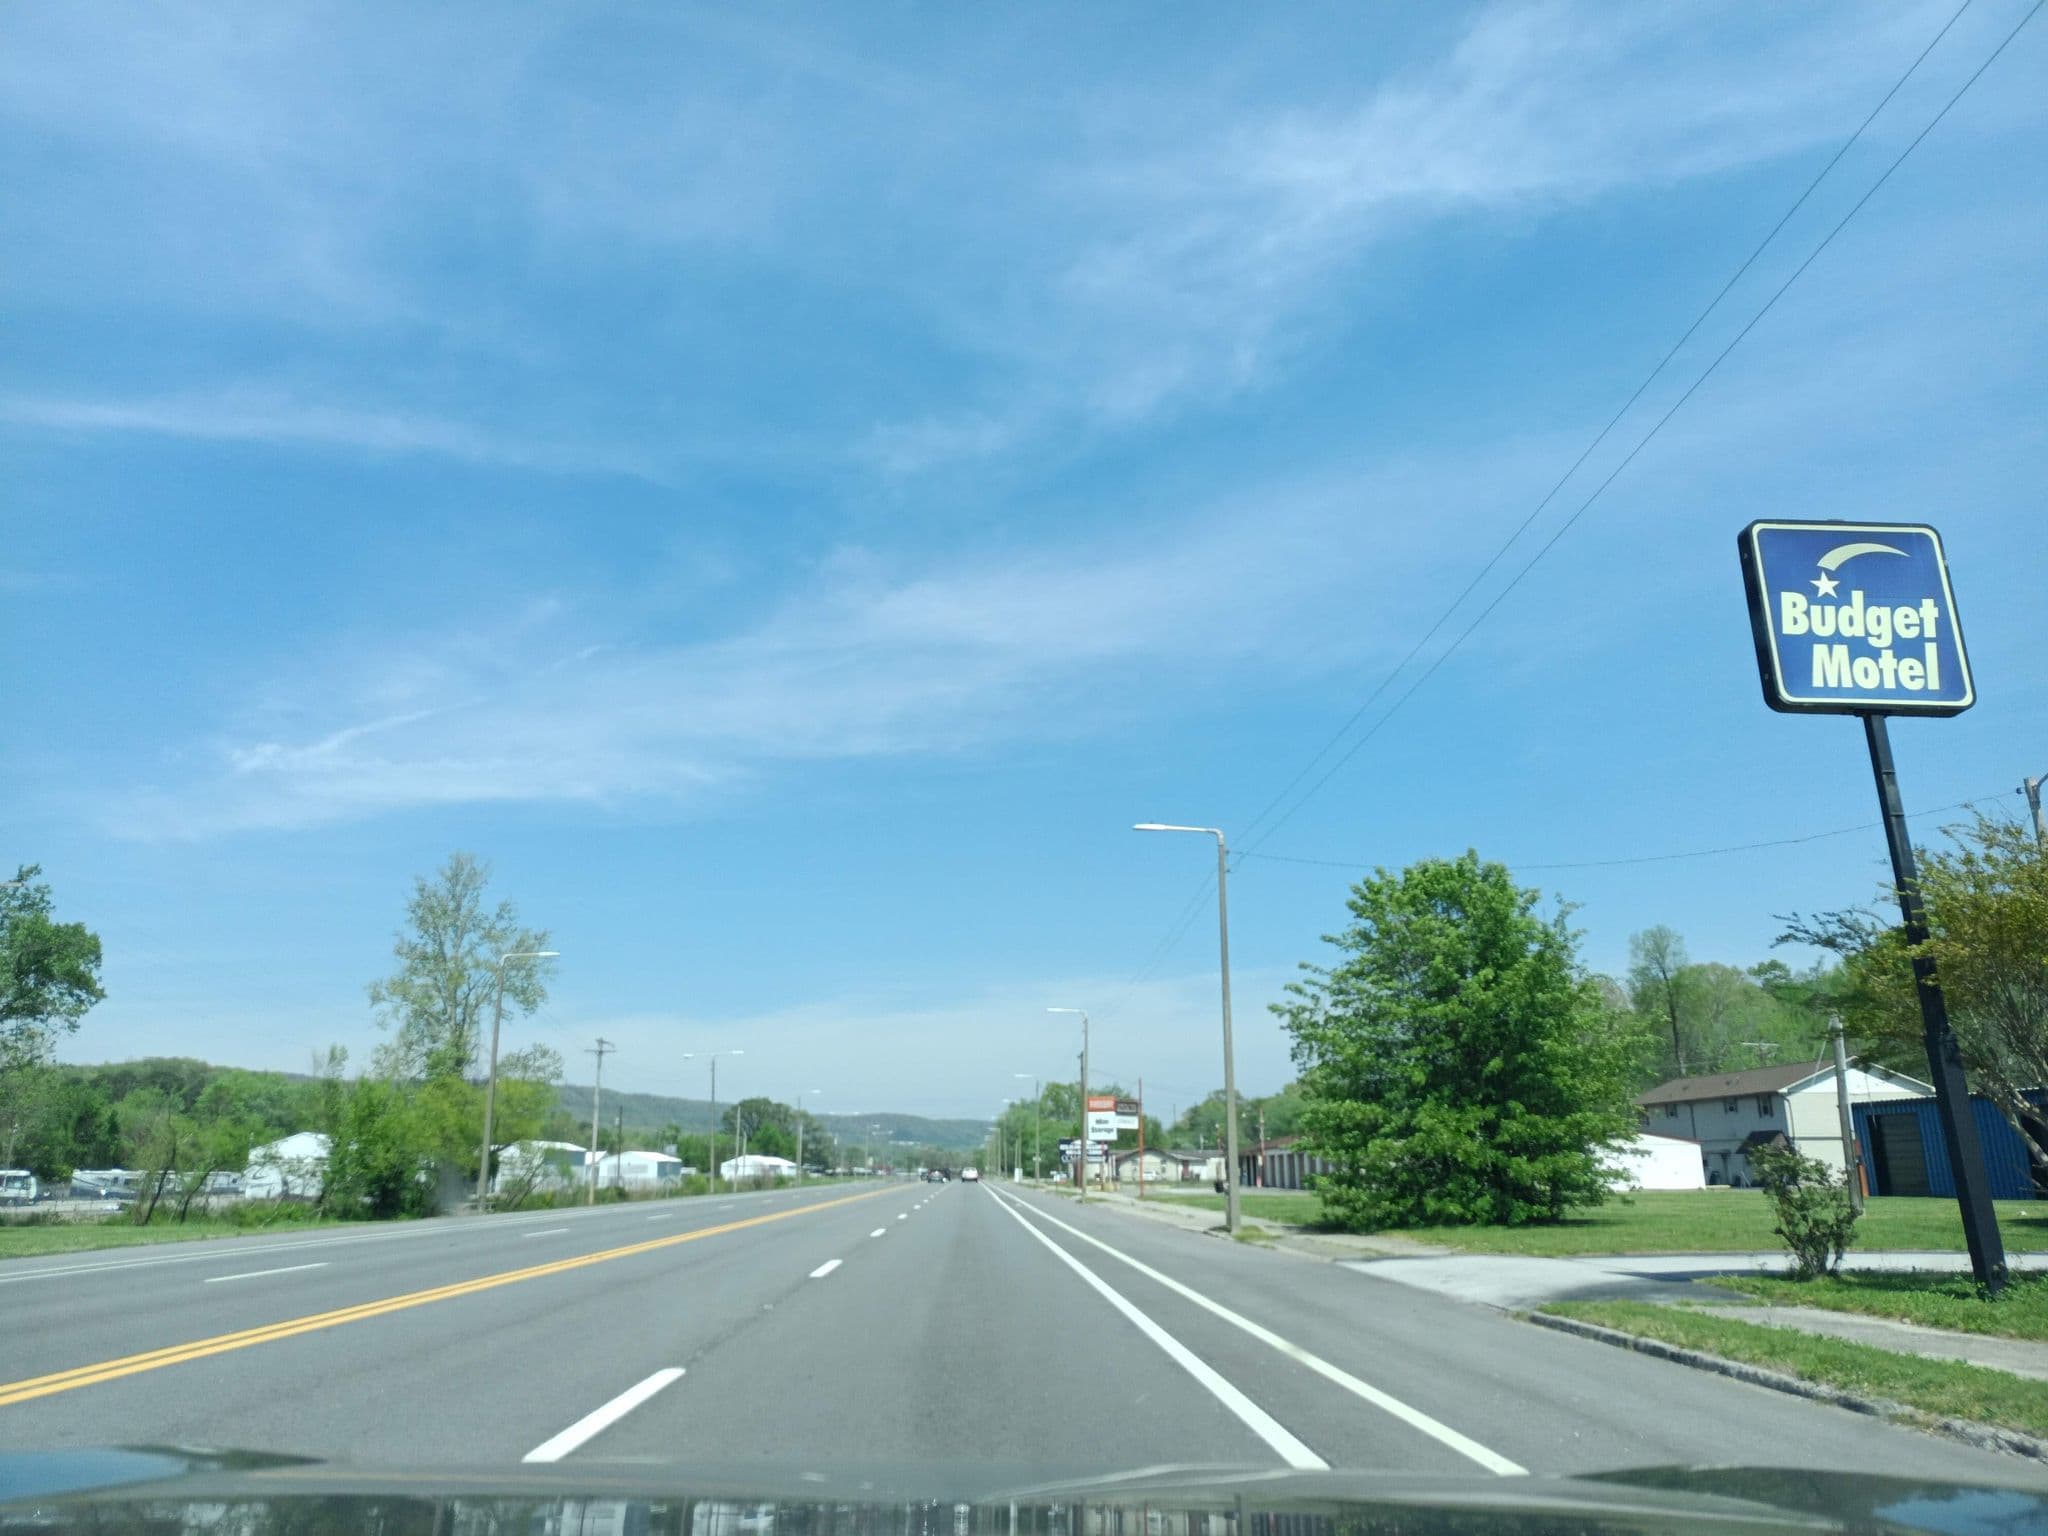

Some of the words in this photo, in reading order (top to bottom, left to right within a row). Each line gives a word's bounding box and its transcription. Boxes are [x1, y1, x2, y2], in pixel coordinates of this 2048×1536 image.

[1780, 590, 1939, 648] Budget
[1811, 642, 1940, 690] Motel
[1091, 1126, 1114, 1134] Storage
